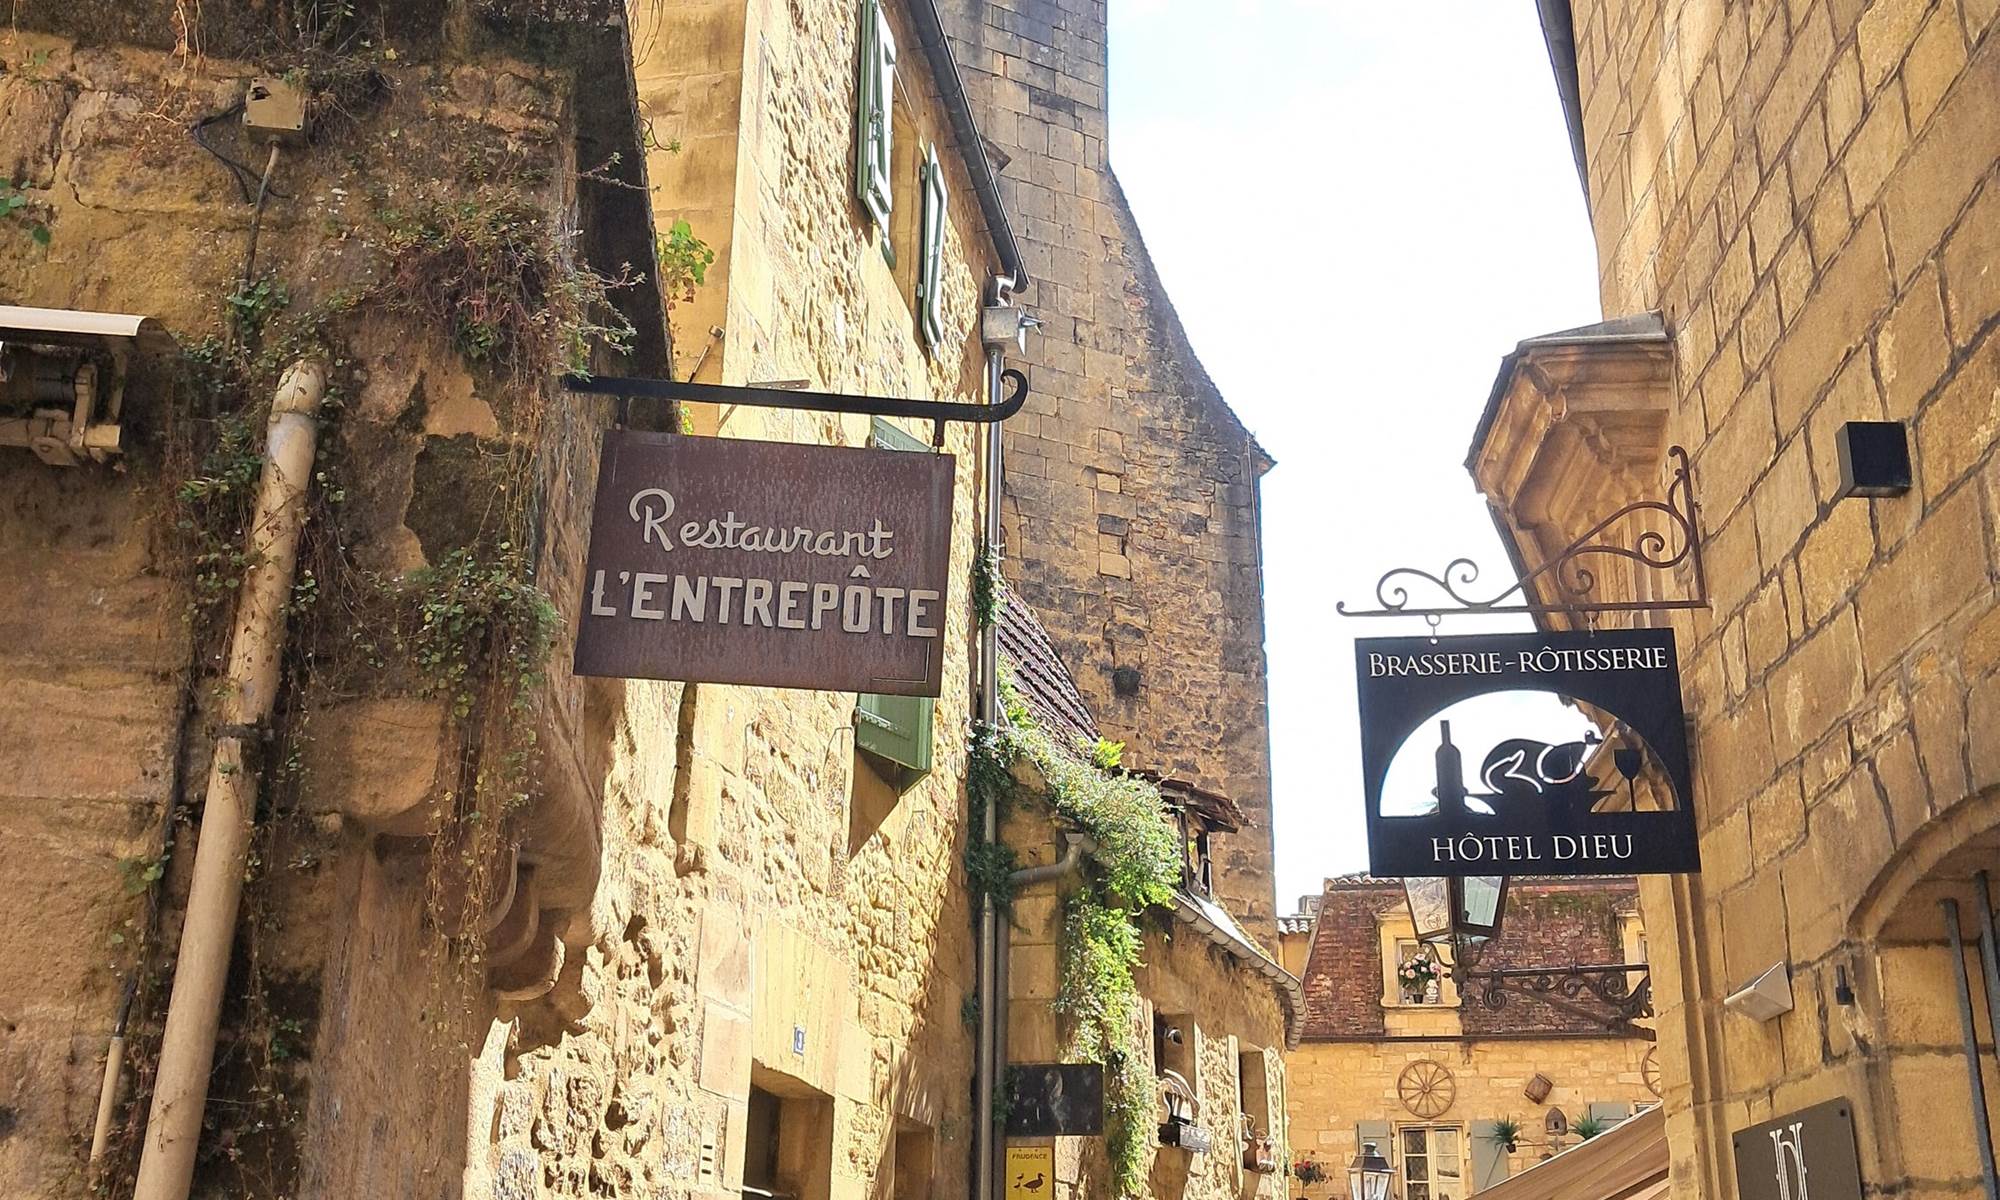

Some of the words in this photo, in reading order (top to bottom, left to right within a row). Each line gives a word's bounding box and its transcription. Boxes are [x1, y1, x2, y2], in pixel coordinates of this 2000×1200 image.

[629, 488, 894, 560] Restaurant
[590, 565, 940, 638] L'ENTREPÔTE
[1431, 832, 1541, 862] HÔTEL
[1553, 834, 1634, 860] DIEU
[1011, 1152, 1048, 1160] PRUDENCE
